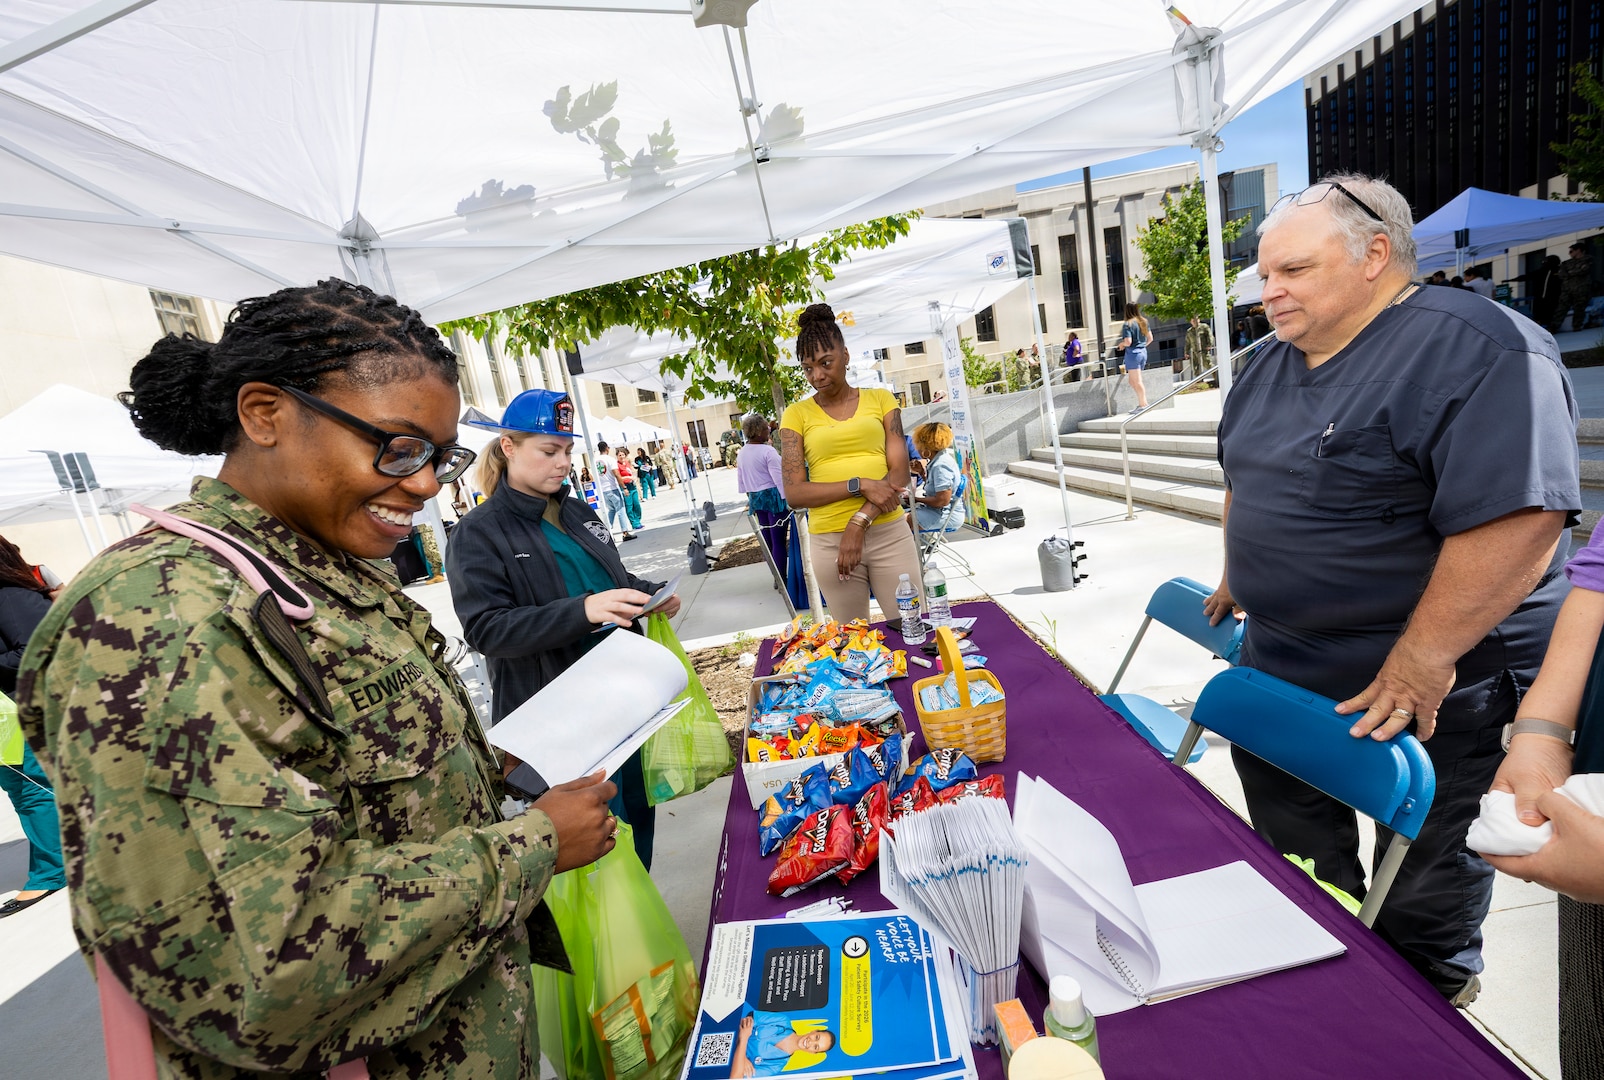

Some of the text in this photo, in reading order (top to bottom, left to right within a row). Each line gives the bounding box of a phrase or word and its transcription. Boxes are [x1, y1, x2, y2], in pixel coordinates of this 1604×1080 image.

[762, 780, 782, 788] USA
[812, 810, 830, 853] Doritos
[875, 929, 898, 963] HEARD!
[886, 922, 910, 963] VOICE BE
[896, 916, 922, 964] LET YOUR
